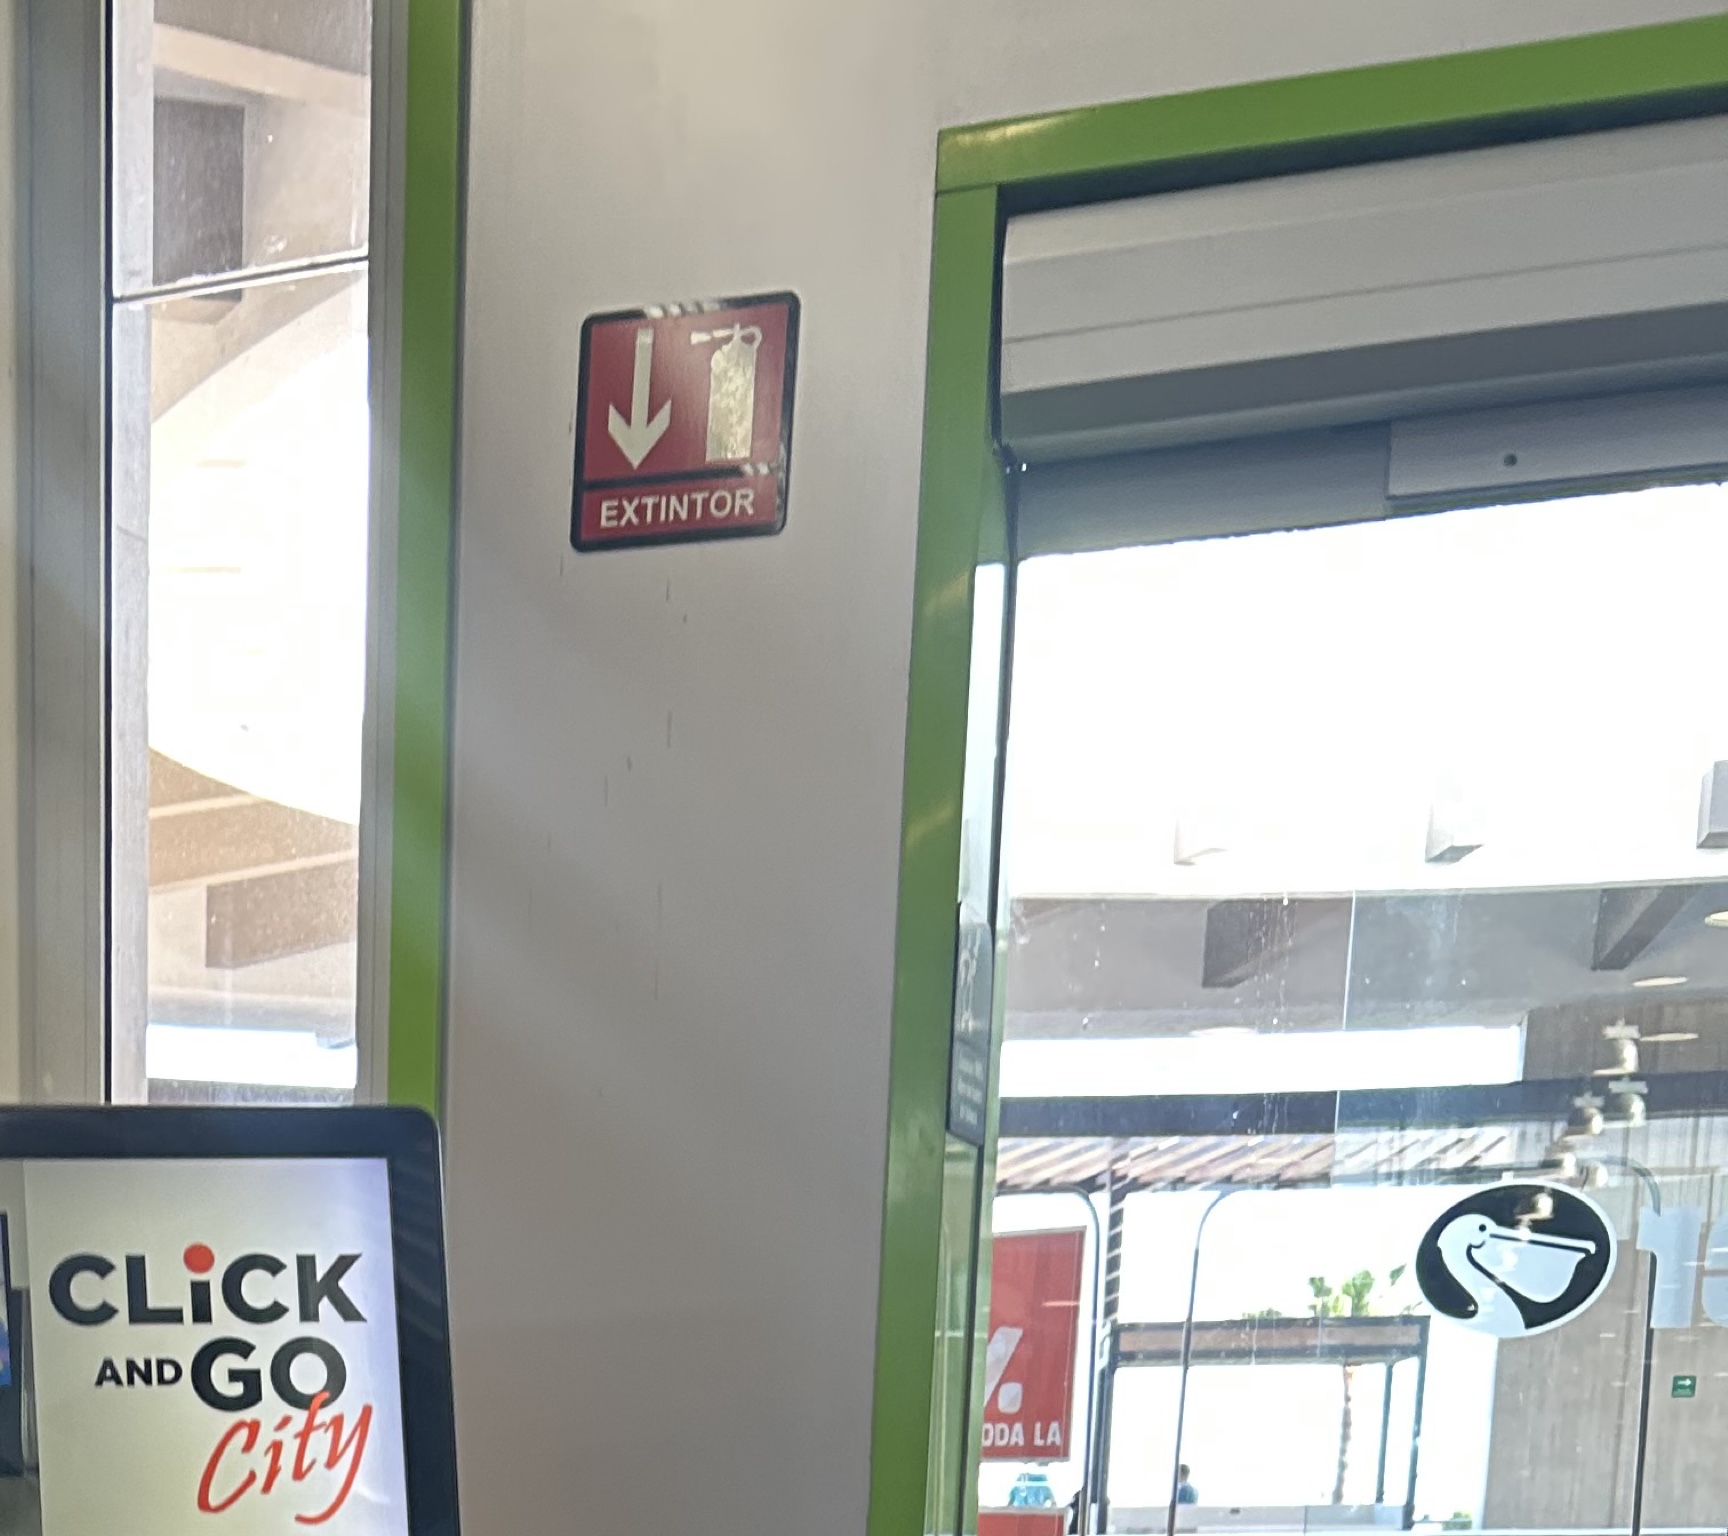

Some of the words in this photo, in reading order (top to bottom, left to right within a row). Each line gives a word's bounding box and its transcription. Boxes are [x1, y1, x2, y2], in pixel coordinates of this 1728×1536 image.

[600, 489, 755, 529] EXTINTOR
[94, 1357, 182, 1388] AND
[191, 1338, 347, 1412] GO
[196, 1391, 374, 1526] City
[981, 1421, 1025, 1447] ODA
[1033, 1420, 1062, 1447] LA
